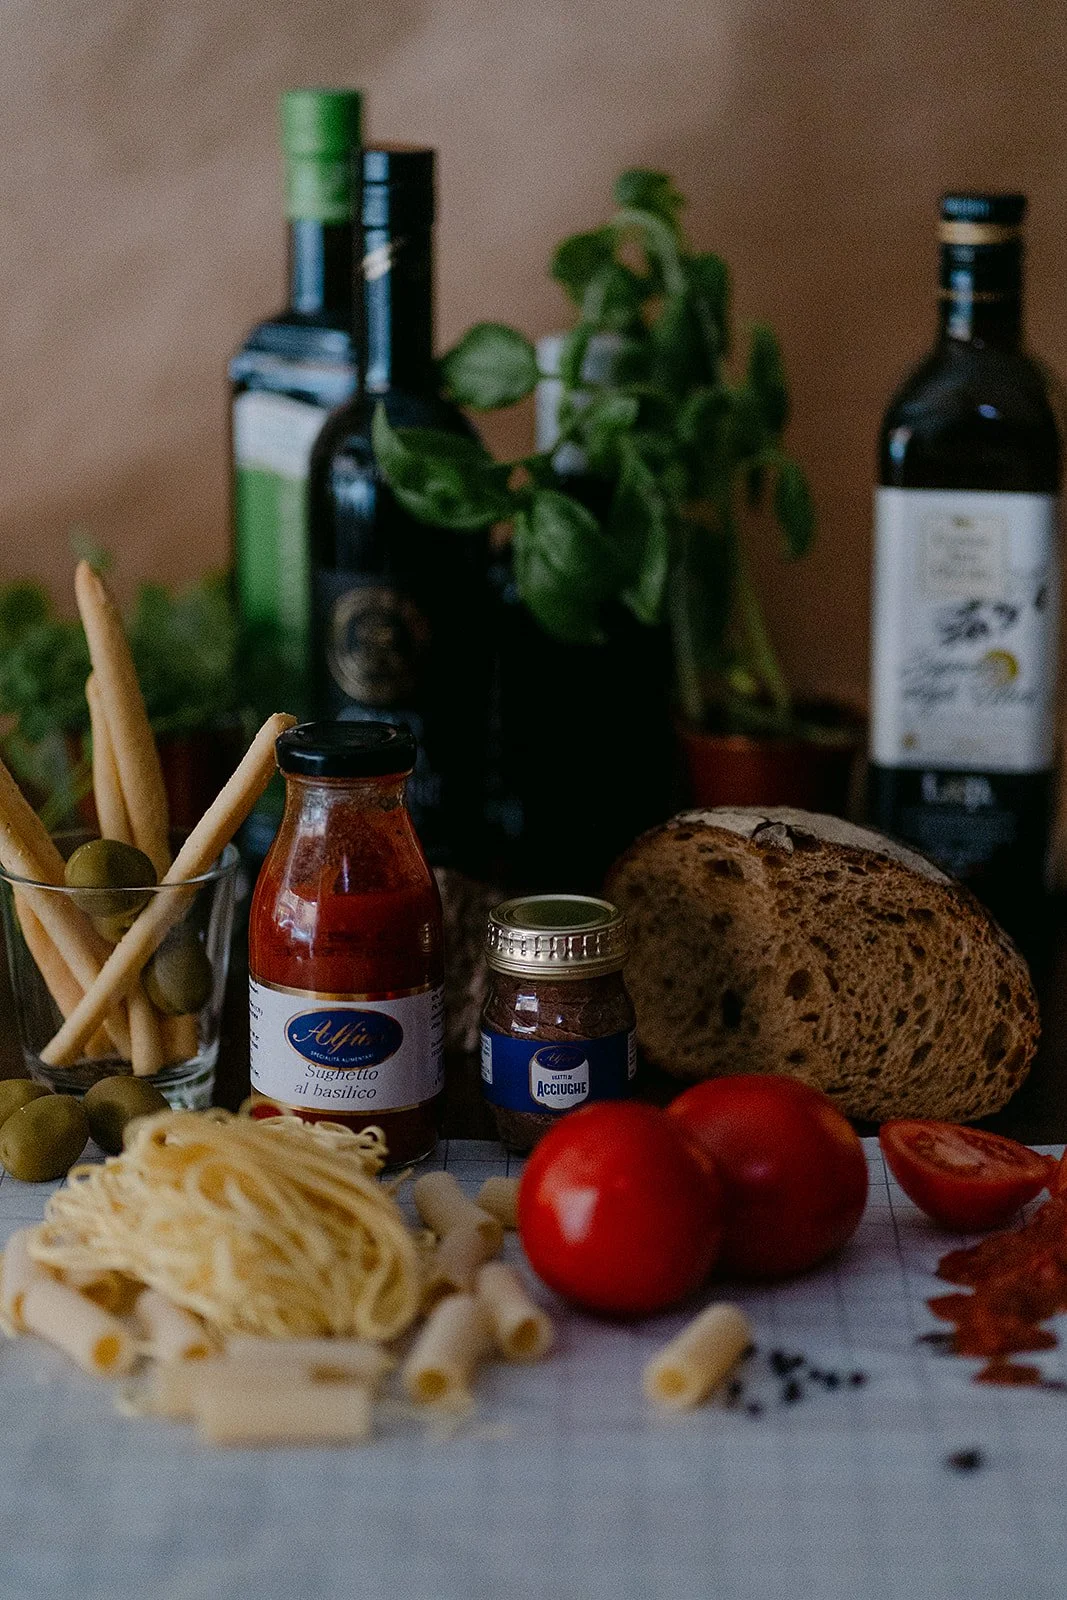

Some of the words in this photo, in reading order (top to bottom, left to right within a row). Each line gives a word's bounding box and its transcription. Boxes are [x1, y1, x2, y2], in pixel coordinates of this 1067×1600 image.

[291, 1019, 386, 1055] Alfie
[341, 1052, 375, 1063] ALIMENTARI
[305, 1064, 379, 1082] Sughetto
[294, 1082, 309, 1094] al
[313, 1082, 377, 1099] basilico
[536, 1080, 587, 1097] ACCIUGHE
